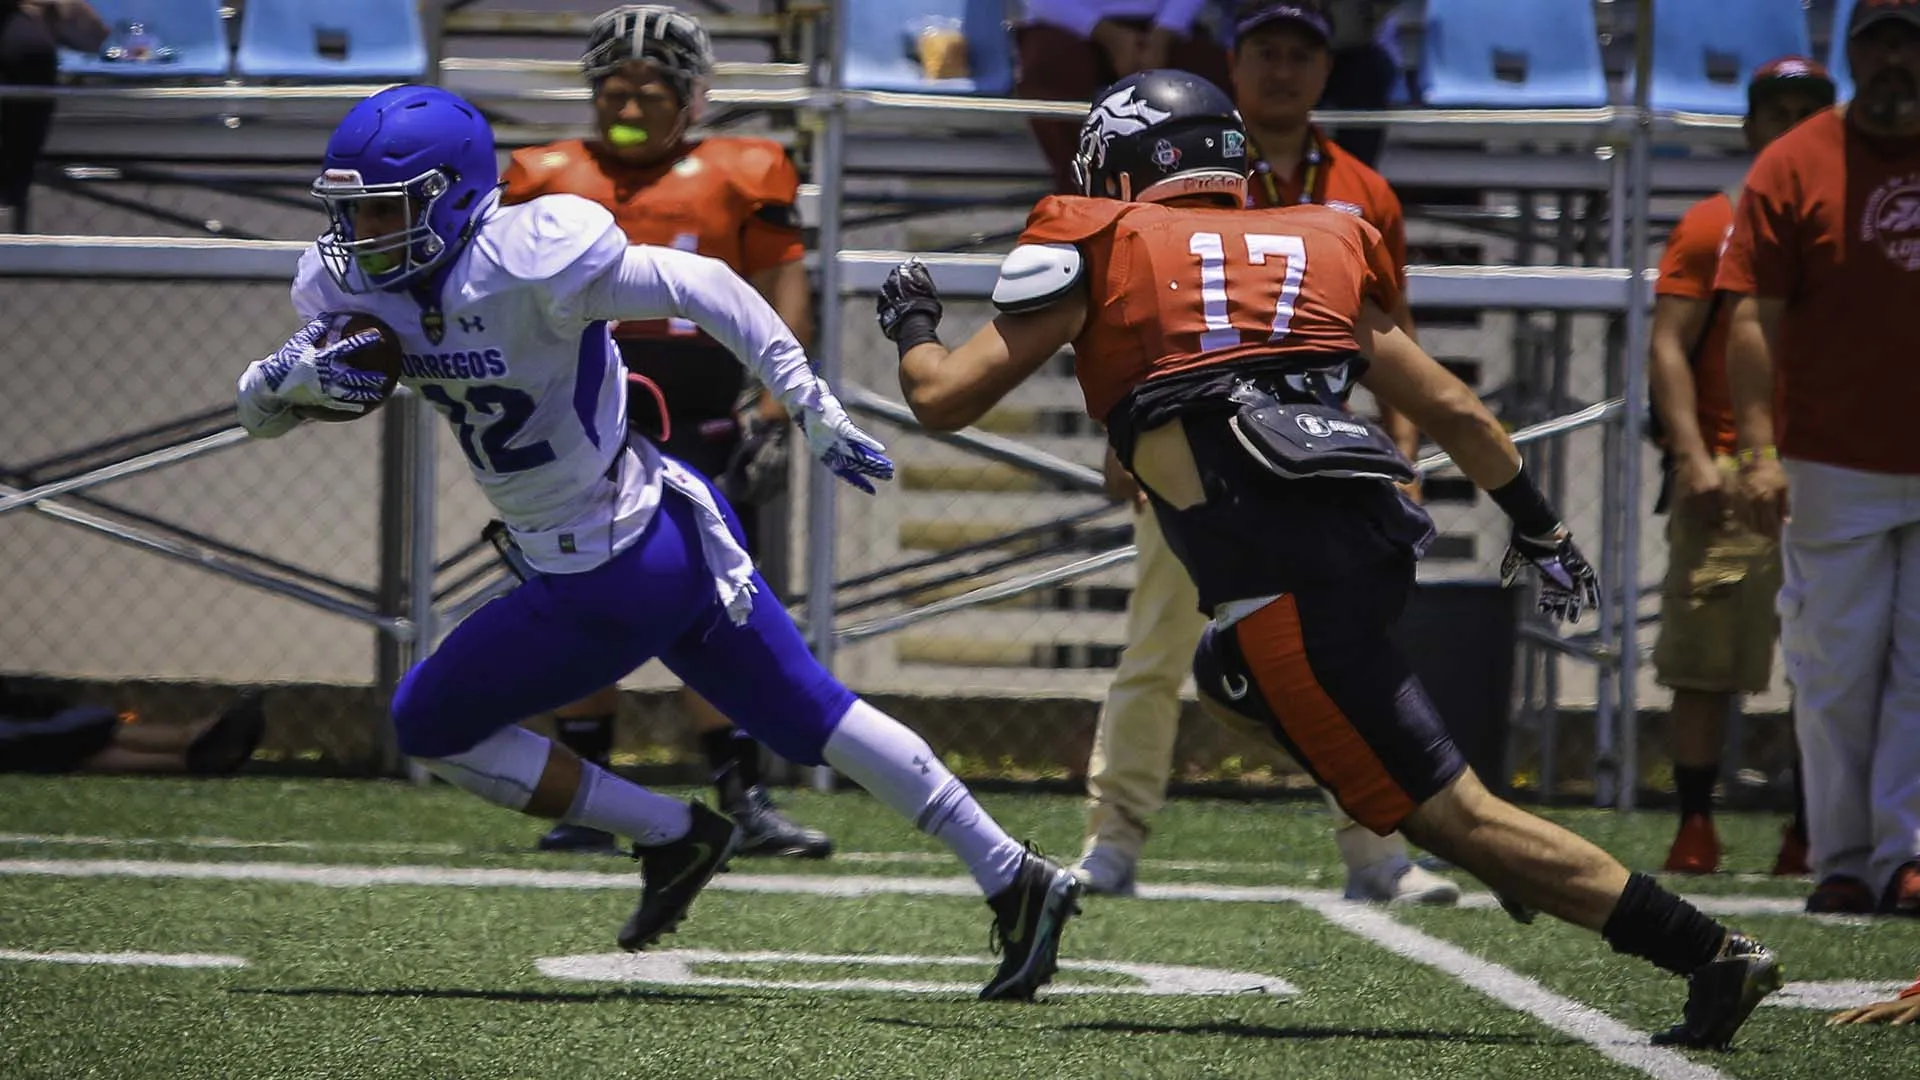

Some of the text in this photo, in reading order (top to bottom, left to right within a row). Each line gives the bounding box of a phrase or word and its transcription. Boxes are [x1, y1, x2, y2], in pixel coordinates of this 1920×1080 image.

[1189, 232, 1307, 353] 17
[401, 348, 508, 380] ORREGOS
[420, 383, 558, 474] 12
